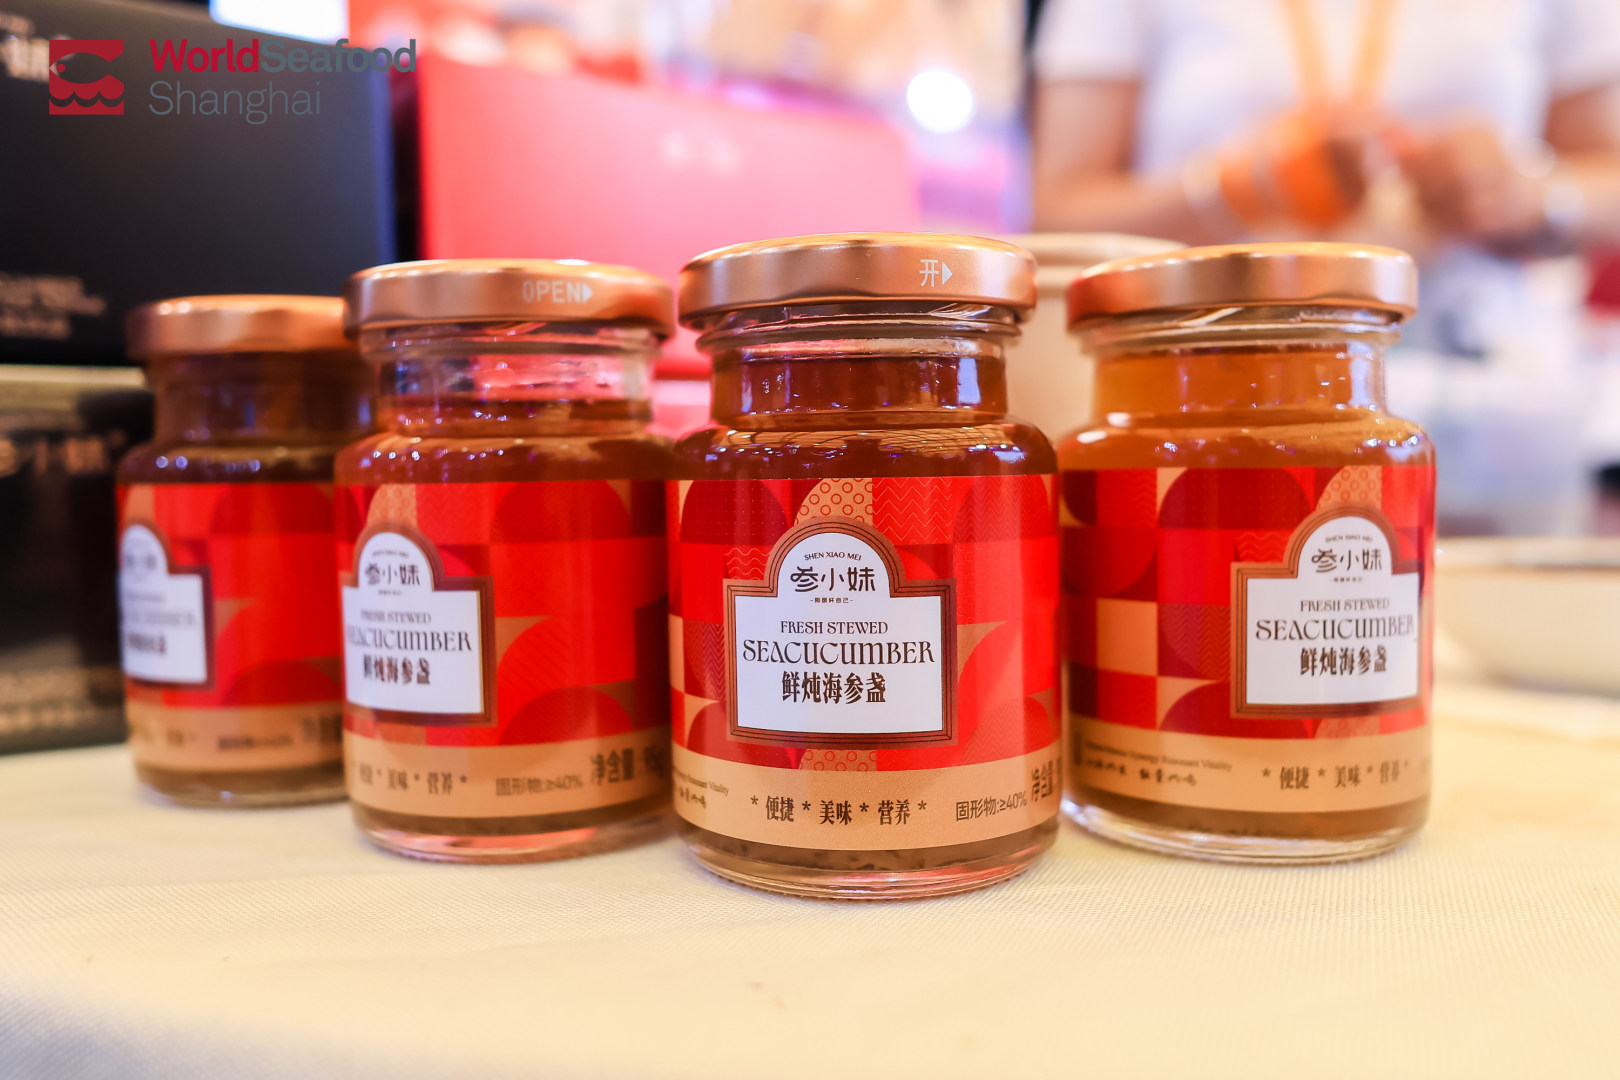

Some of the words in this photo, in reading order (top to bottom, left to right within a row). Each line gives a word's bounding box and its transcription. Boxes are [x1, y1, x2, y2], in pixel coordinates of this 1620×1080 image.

[919, 259, 940, 288] 开
[521, 279, 581, 304] OPEN
[804, 552, 825, 561] SHEN
[826, 551, 845, 559] XIAO
[847, 552, 862, 561] MEI
[1300, 599, 1340, 612] FRESH
[1343, 597, 1390, 611] STEWED
[780, 621, 823, 634] FRESH
[827, 621, 889, 634] STEWED
[1255, 615, 1415, 641] SEACUCUMBER
[743, 639, 936, 665] SEACUCUMBER
[1300, 645, 1387, 676] 鲜炖海参盏
[782, 671, 886, 704] 鲜炖海参盏
[1334, 764, 1361, 788] 美味
[765, 795, 795, 822] 便捷
[820, 800, 853, 826] 美味
[877, 799, 911, 826] 营养
